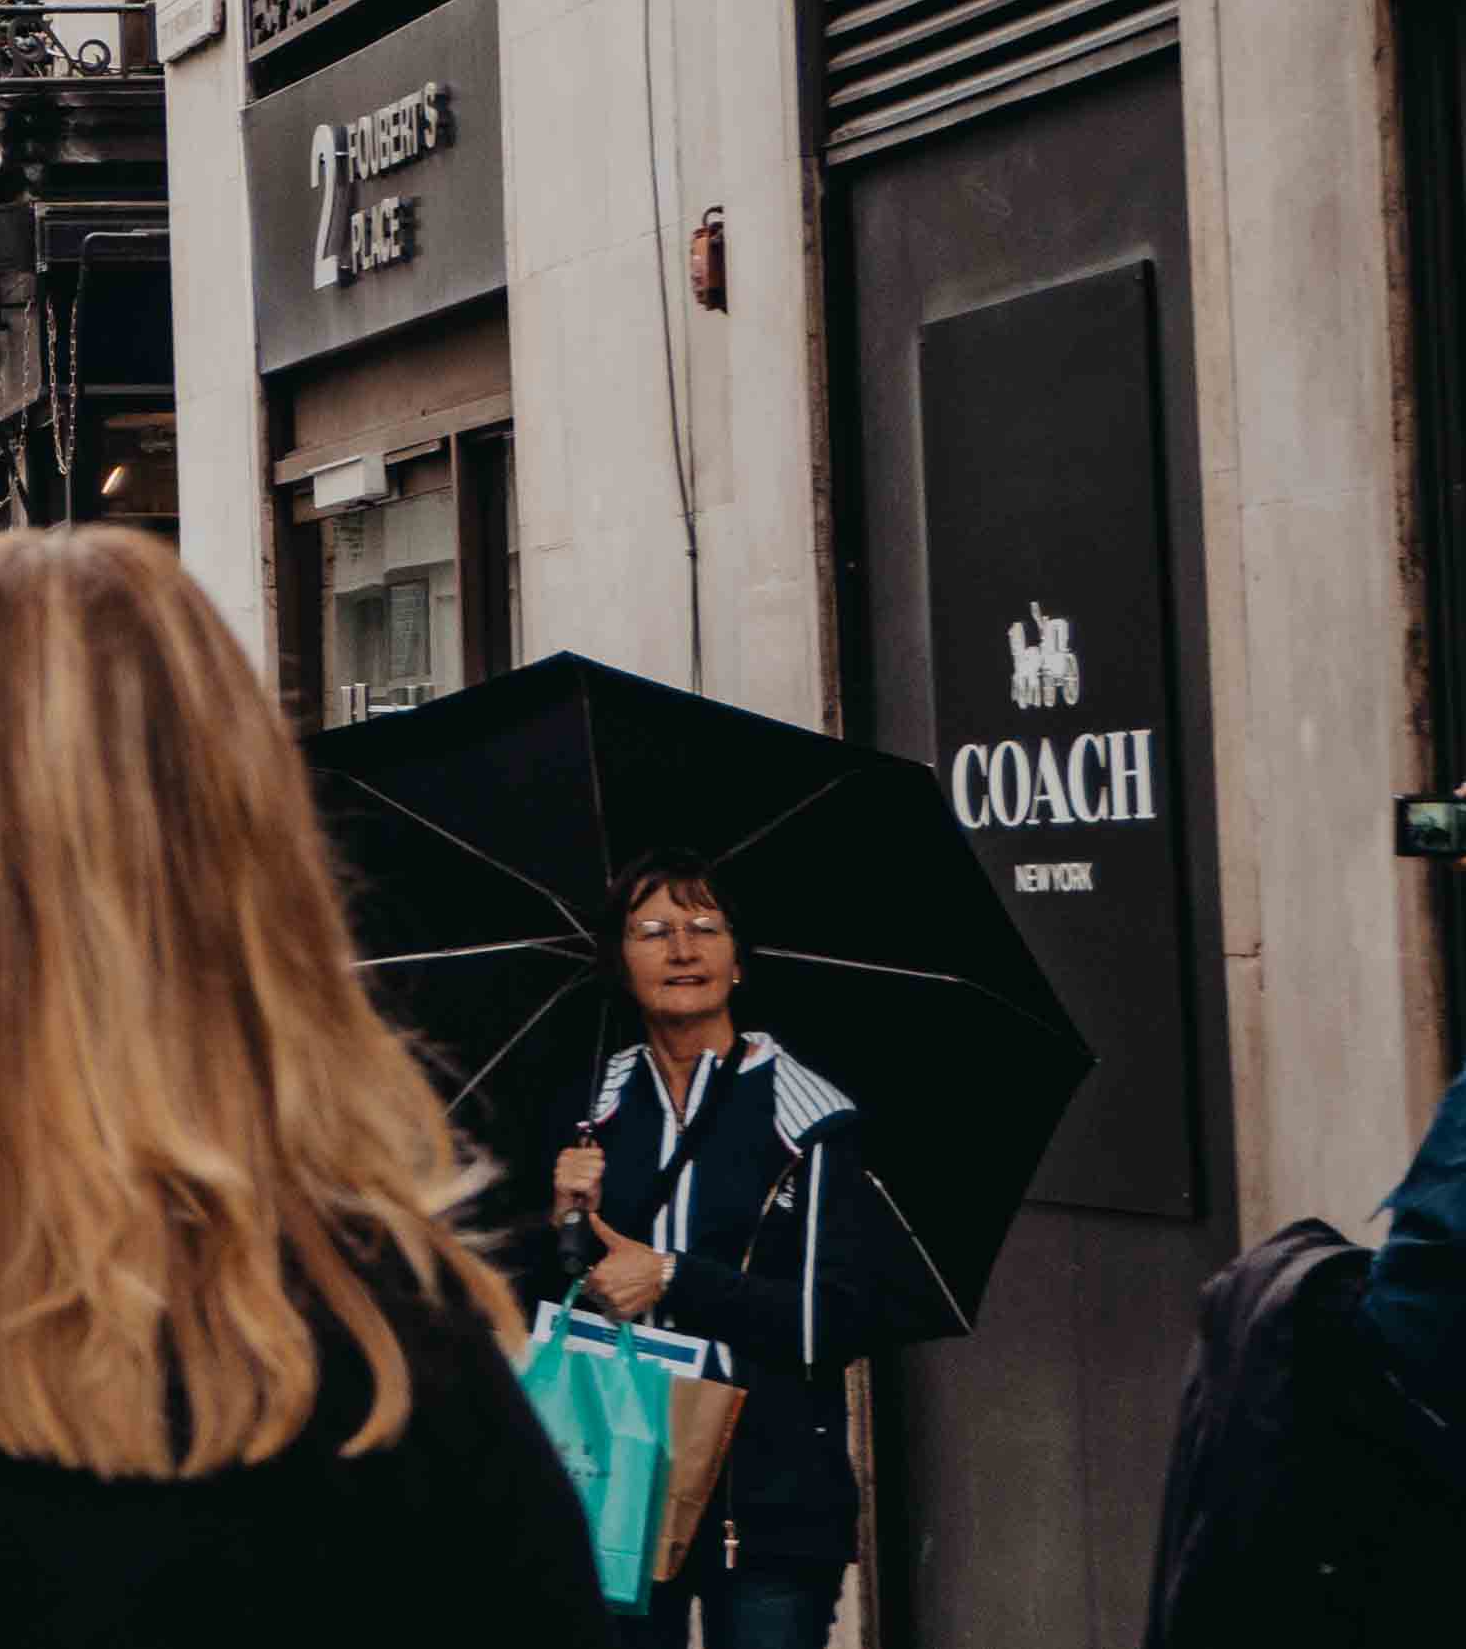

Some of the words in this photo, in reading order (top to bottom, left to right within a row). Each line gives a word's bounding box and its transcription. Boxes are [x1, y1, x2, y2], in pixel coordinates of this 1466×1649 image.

[310, 124, 338, 290] 2
[351, 196, 402, 275] PLACE
[952, 729, 1157, 828] COACH
[1015, 864, 1049, 892] NEW
[1050, 862, 1094, 891] YORK
